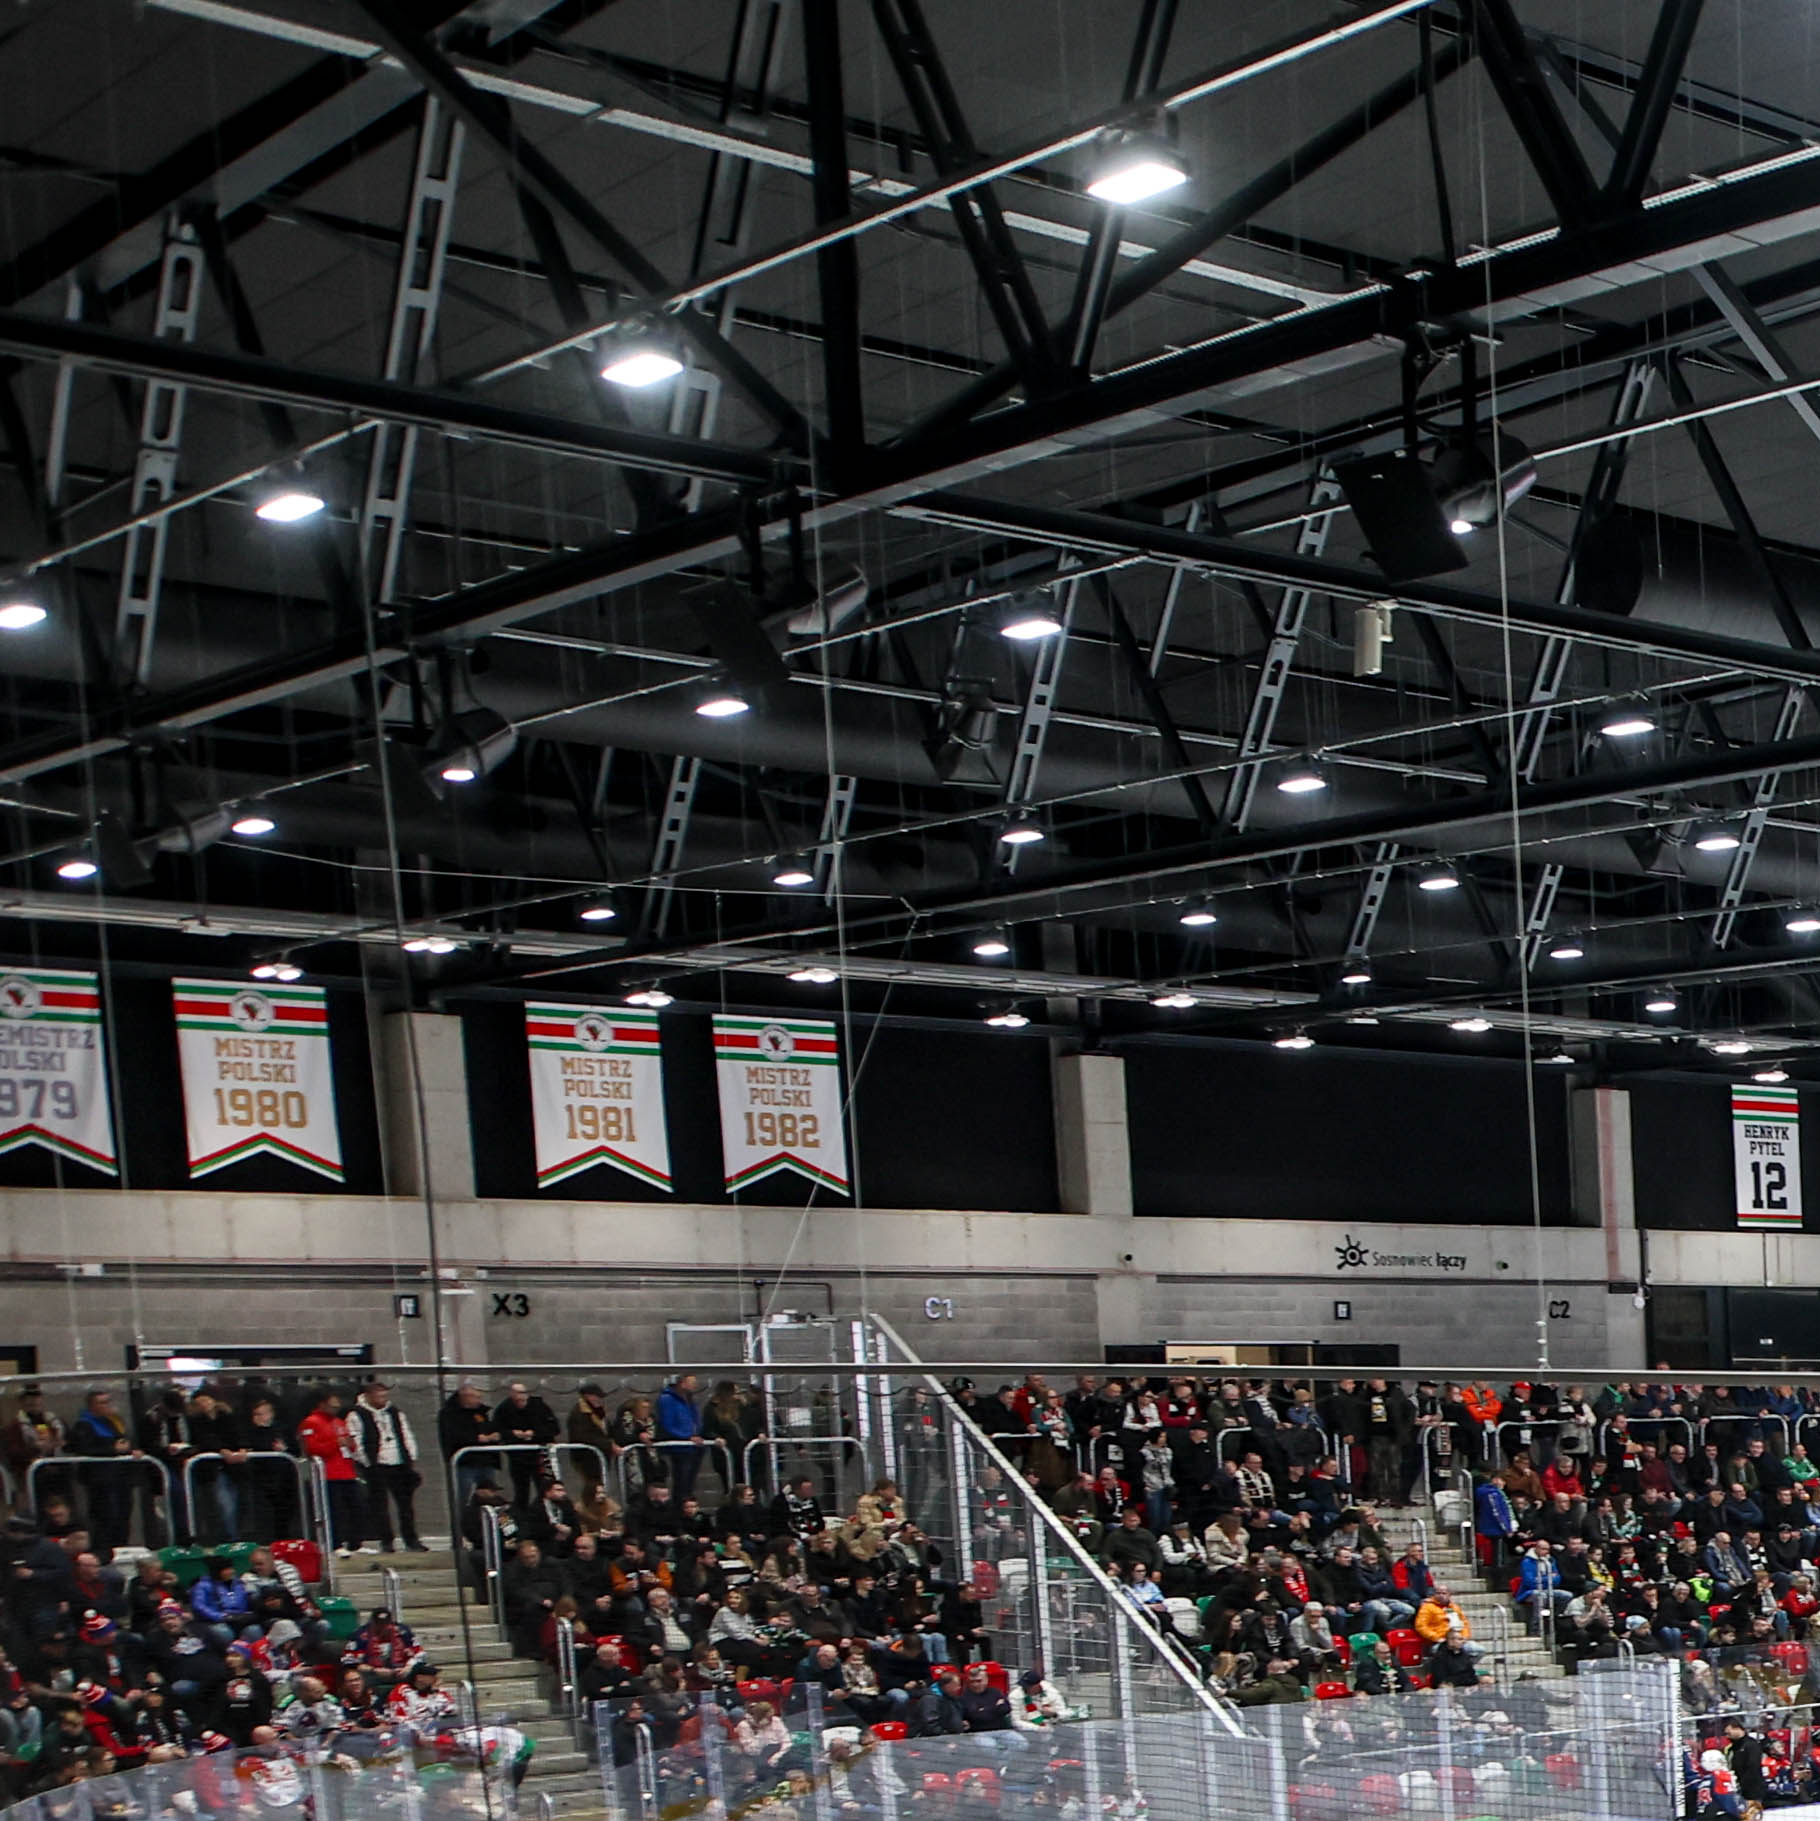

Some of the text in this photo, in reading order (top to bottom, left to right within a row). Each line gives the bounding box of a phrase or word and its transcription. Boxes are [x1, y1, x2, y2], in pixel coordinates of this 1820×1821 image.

[214, 1037, 296, 1060] MISTRZ
[218, 1060, 297, 1083] POLSKI
[560, 1056, 633, 1078] MISTRZ
[745, 1066, 812, 1086] MISTRZ
[563, 1079, 632, 1099] POLSKI
[748, 1087, 812, 1107] POLSKI
[213, 1088, 308, 1128] 1980
[565, 1103, 638, 1142] 1981
[744, 1111, 820, 1148] 1982
[1744, 1124, 1790, 1140] HENRYK
[1750, 1141, 1785, 1156] PYTEL
[1751, 1161, 1788, 1210] 12
[1436, 1252, 1467, 1271] łączy
[492, 1293, 529, 1317] X3
[925, 1296, 953, 1319] C1
[1549, 1300, 1570, 1319] C2
